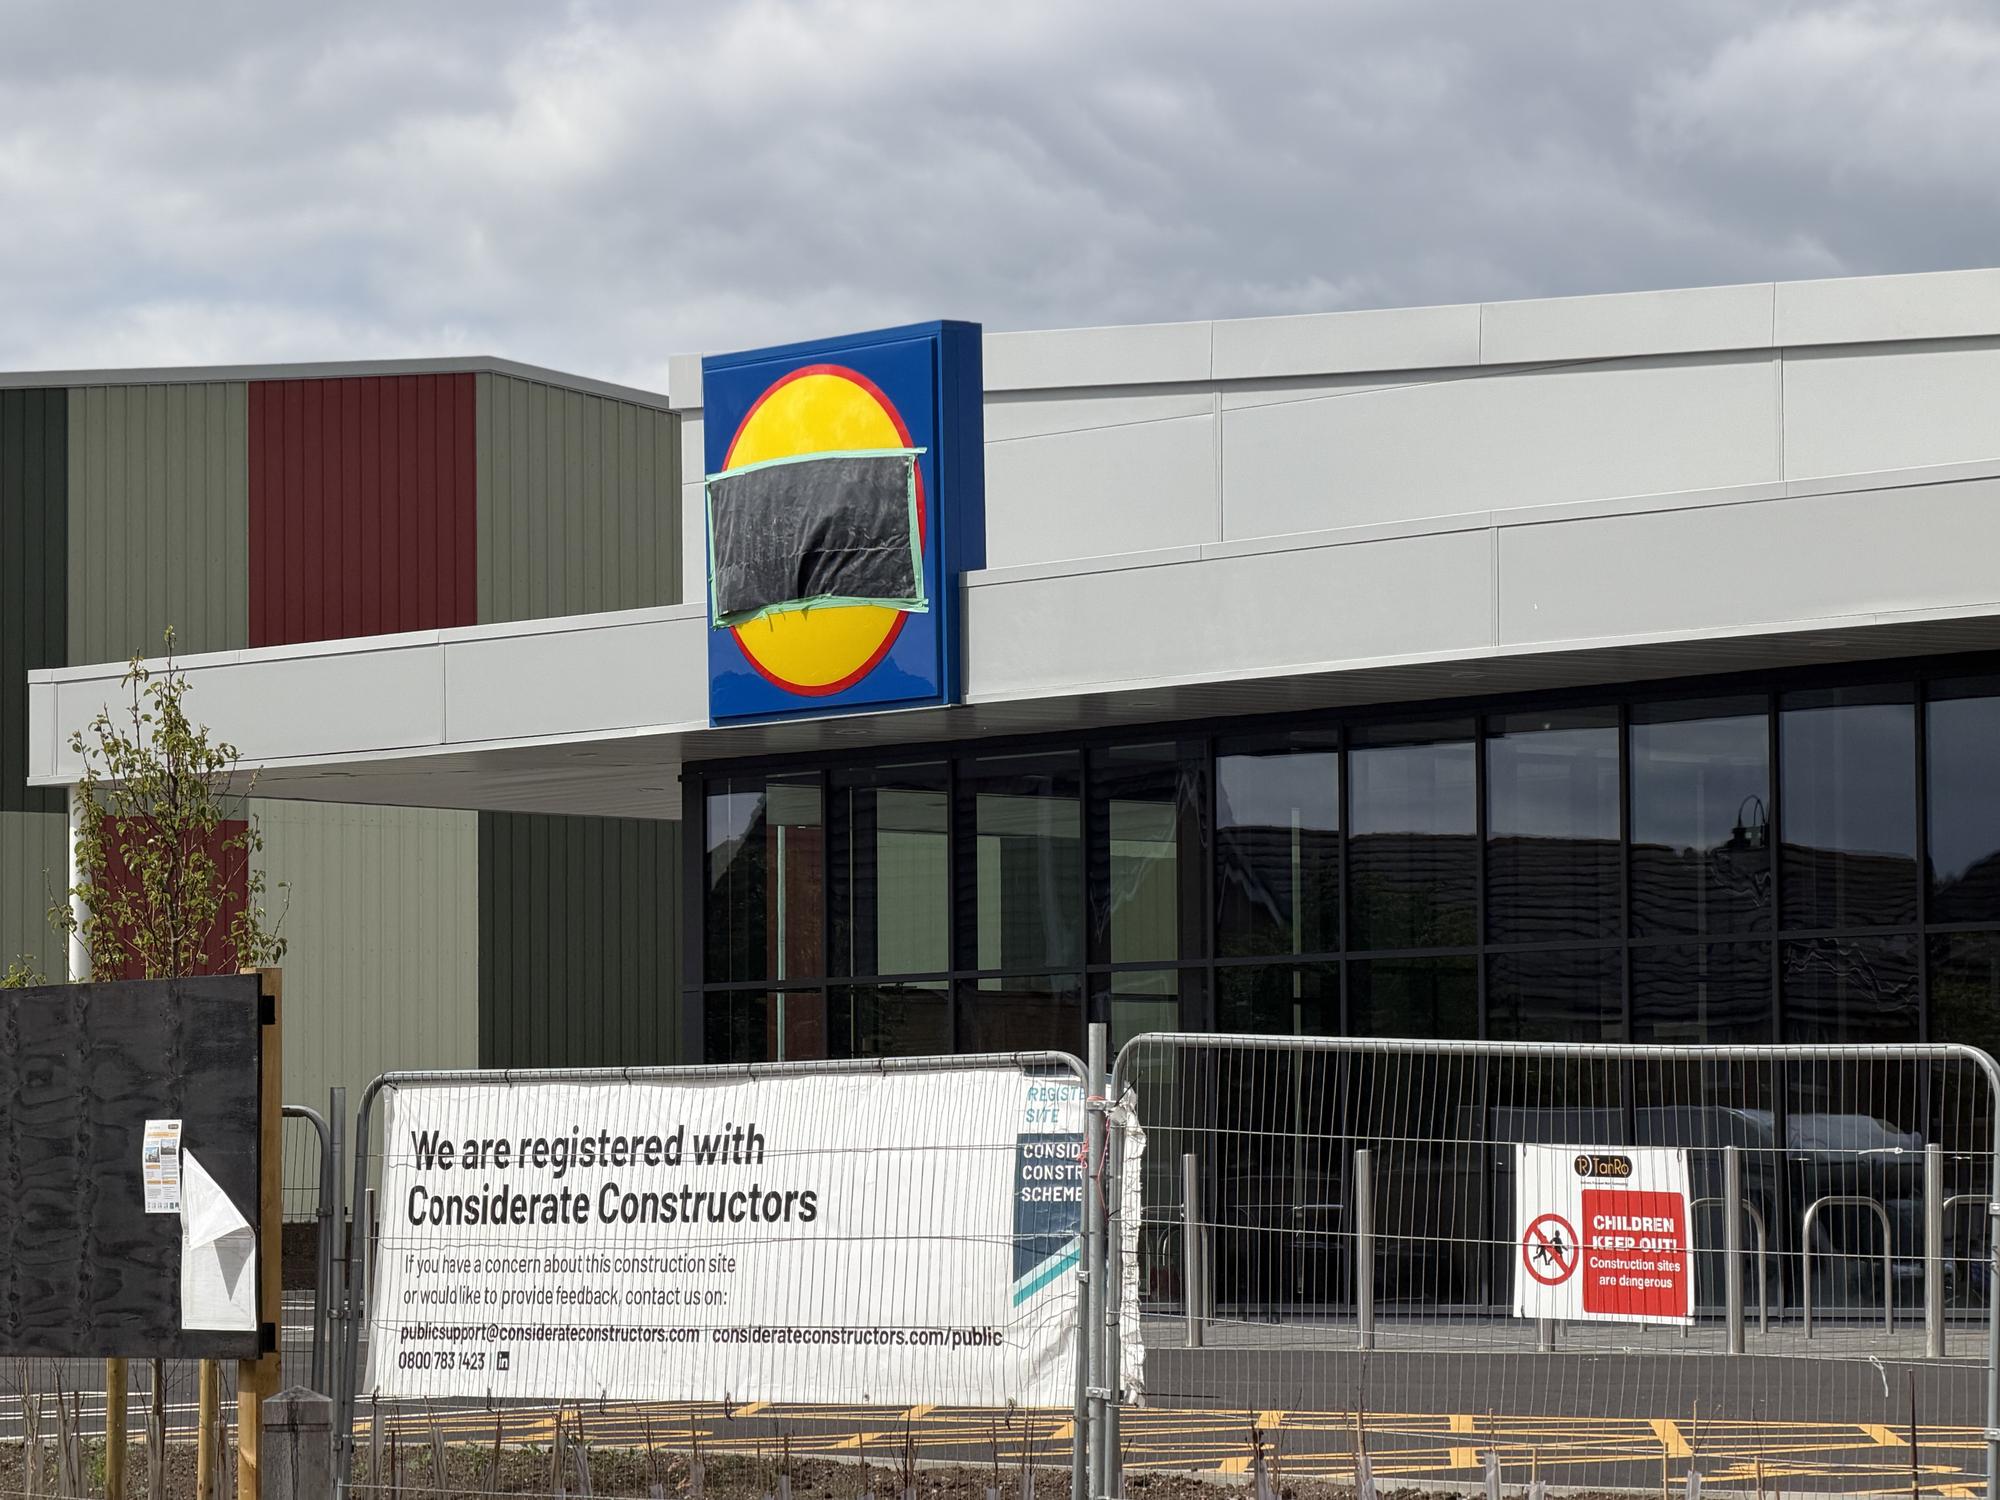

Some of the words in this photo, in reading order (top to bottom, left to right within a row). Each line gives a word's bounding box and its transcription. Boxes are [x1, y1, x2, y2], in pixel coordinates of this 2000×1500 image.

[1028, 1086, 1085, 1102] REGISTE
[1025, 1108, 1059, 1123] SITE
[411, 1130, 455, 1171] We
[462, 1139, 511, 1170] are
[519, 1124, 685, 1179] registered
[693, 1122, 765, 1166] with
[1023, 1143, 1081, 1159] CONSID
[1022, 1165, 1083, 1181] CONSTR
[1593, 1157, 1629, 1175] TanRo
[1021, 1186, 1082, 1202] SCHEME
[408, 1182, 590, 1226] Considerate
[598, 1181, 818, 1225] Constructors
[1593, 1215, 1674, 1233] CHILDREN
[1592, 1236, 1635, 1252] KEEP
[1639, 1238, 1677, 1254] OUT!
[405, 1254, 414, 1274] If
[417, 1259, 439, 1279] you
[442, 1254, 471, 1274] have
[473, 1260, 481, 1273] a
[485, 1258, 541, 1273] concern
[544, 1254, 583, 1273] about
[586, 1254, 611, 1273] this
[614, 1253, 705, 1273] construction
[709, 1253, 736, 1273] site
[1590, 1257, 1654, 1271] Construction
[1657, 1259, 1680, 1272] sites
[1599, 1276, 1617, 1286] are
[1619, 1275, 1672, 1290] dangerous
[404, 1290, 417, 1304] or
[420, 1285, 457, 1304] would
[459, 1285, 481, 1304] like
[484, 1287, 497, 1305] to
[501, 1285, 553, 1310] provide
[556, 1286, 622, 1308] feedback,
[625, 1287, 680, 1305] contact
[684, 1290, 701, 1305] us
[704, 1291, 727, 1305] on:
[400, 1321, 699, 1345] publicsupport@considerateconstructors.com
[712, 1324, 1003, 1351] considerateconstructors.com/public
[398, 1351, 431, 1370] 0800
[434, 1351, 456, 1370] 783
[458, 1351, 486, 1370] 1423
